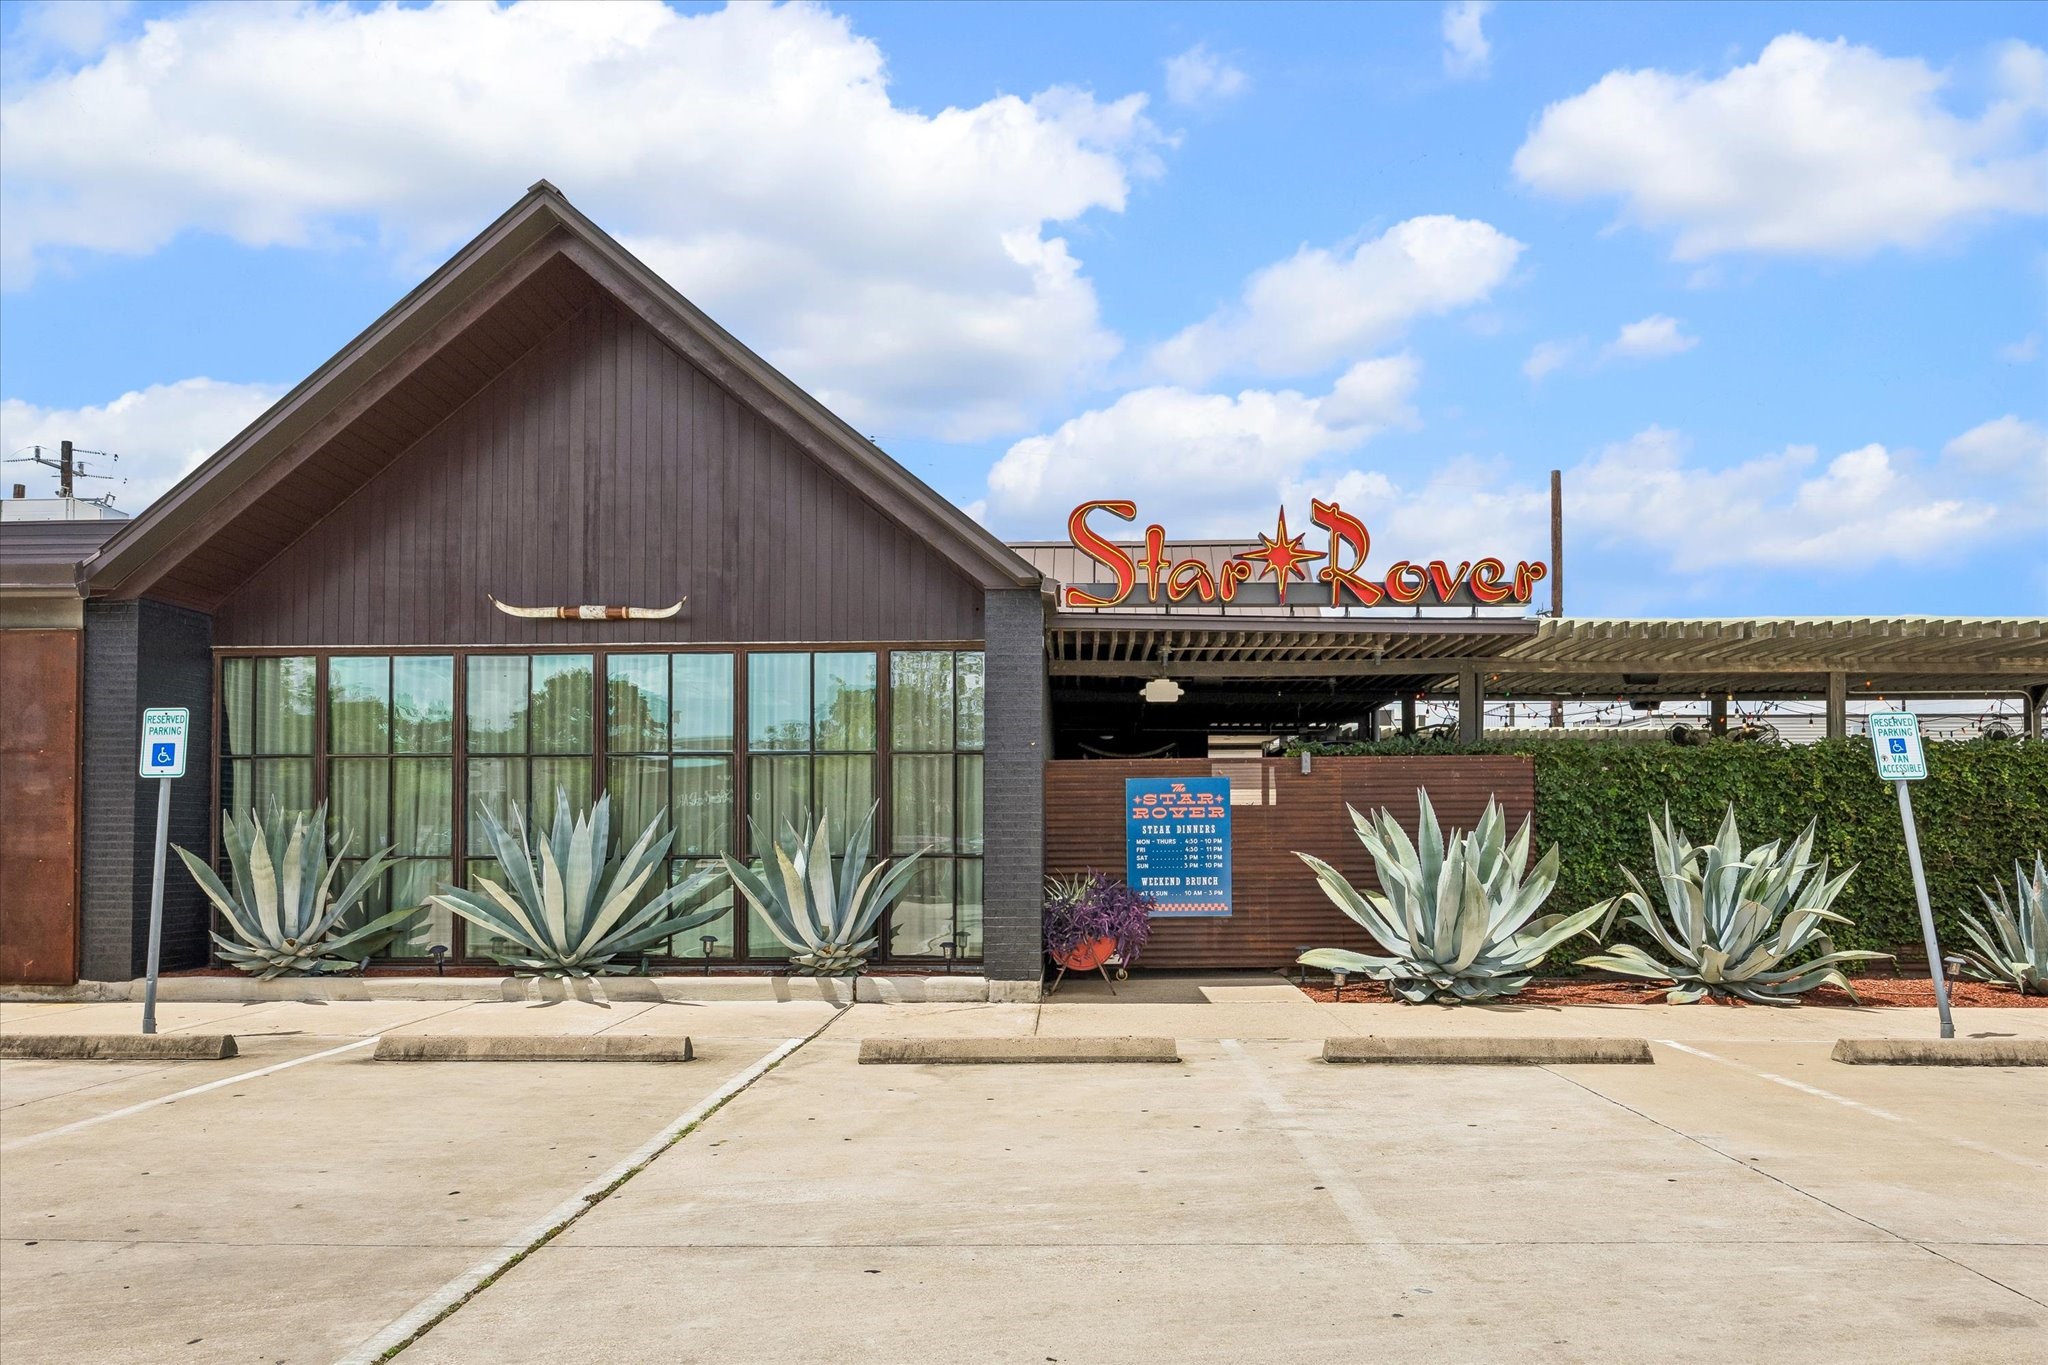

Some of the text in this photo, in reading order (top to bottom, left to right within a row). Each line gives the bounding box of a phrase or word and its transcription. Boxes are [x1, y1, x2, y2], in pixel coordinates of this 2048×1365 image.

[1066, 497, 1548, 608] Star Rover
[147, 715, 185, 724] RESERVED
[1874, 718, 1913, 727] RESERVED
[149, 727, 182, 735] PARKING
[1878, 728, 1913, 736] PARKING
[1891, 755, 1910, 763] VAN
[1883, 764, 1922, 773] ACCESSIBLE
[1171, 783, 1186, 792] The
[1143, 793, 1214, 806] STAR
[1132, 806, 1225, 819] ROVER
[1142, 824, 1216, 834] STEAK DINNERS
[1141, 876, 1219, 886] WEEKEND BRUNCH
